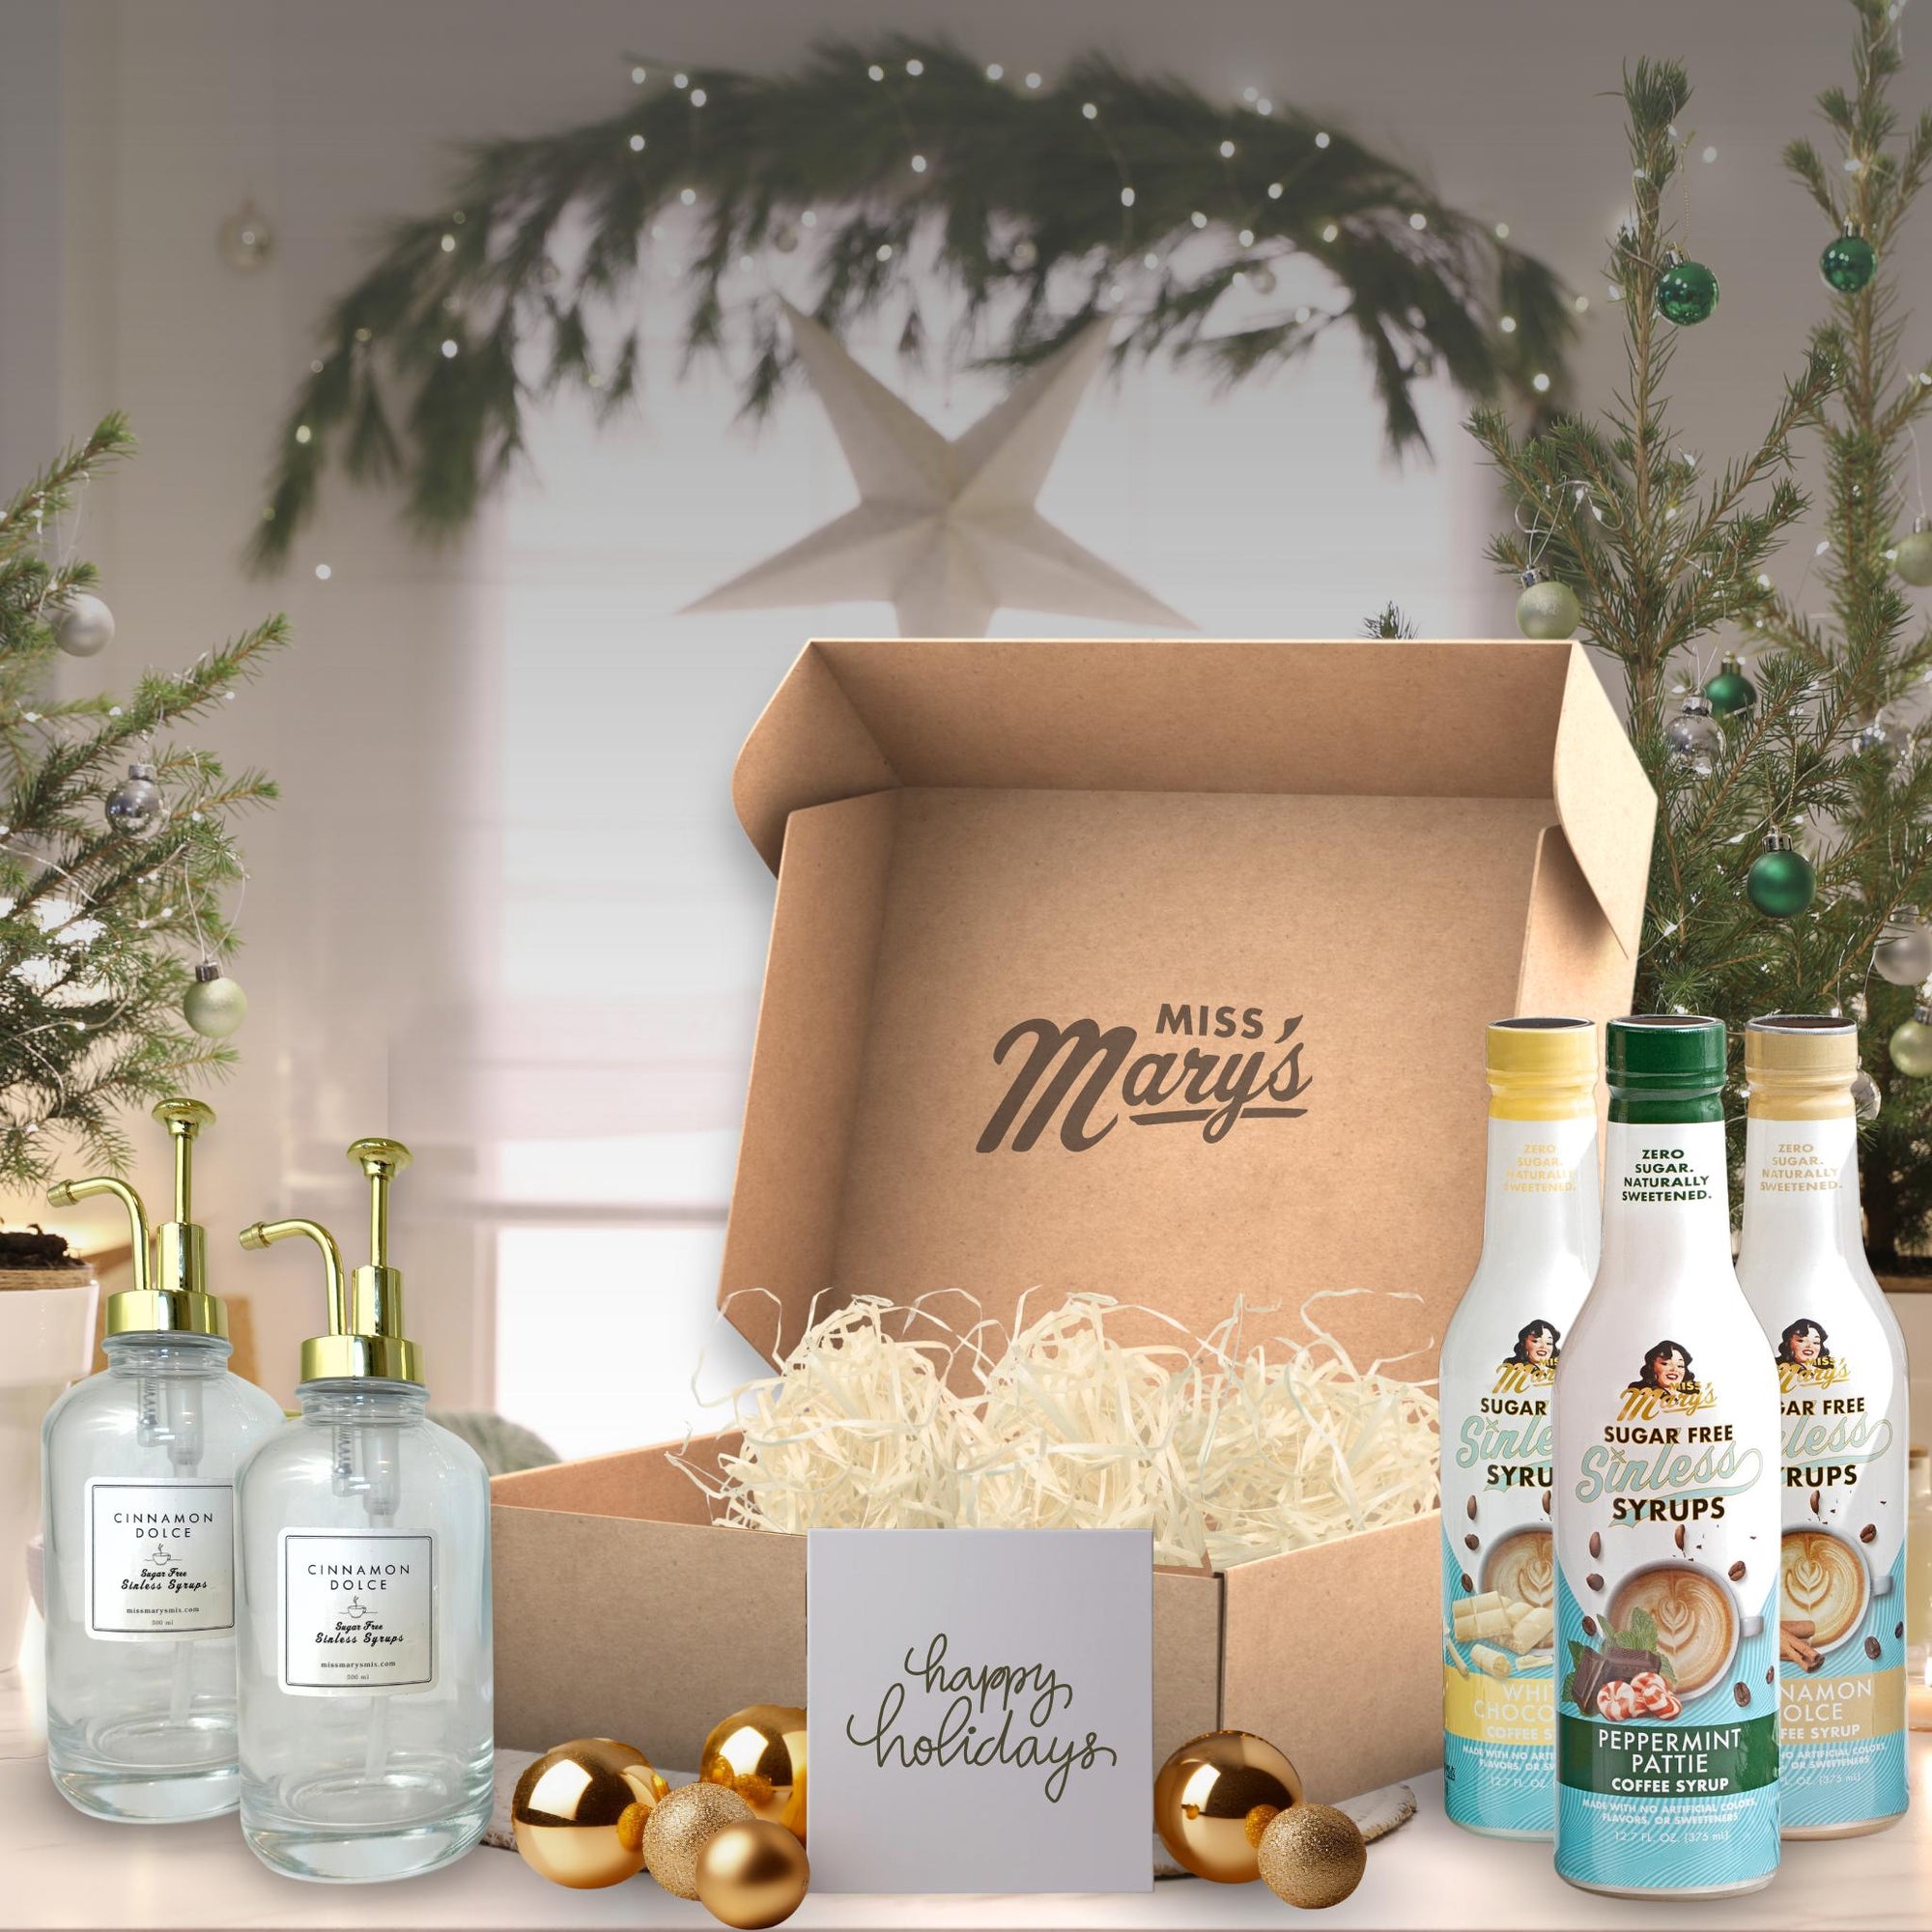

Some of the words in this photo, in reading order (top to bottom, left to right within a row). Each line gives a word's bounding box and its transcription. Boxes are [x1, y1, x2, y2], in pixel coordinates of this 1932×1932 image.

[1155, 1003, 1264, 1039] MISS
[976, 1014, 1313, 1152] Mary's
[1523, 1144, 1556, 1154] ZERO
[1641, 1149, 1685, 1160] ZERO
[1777, 1143, 1815, 1153] ZERO
[1634, 1162, 1694, 1174] SUGAR.
[1771, 1155, 1825, 1167] SUGAR.
[1761, 1167, 1839, 1179] NATURALLY
[1624, 1175, 1710, 1188] NATURALLY
[1759, 1180, 1844, 1192] SWEETENED.
[1622, 1189, 1713, 1202] SWEETENED.
[1806, 1356, 1835, 1366] MISS
[1492, 1362, 1556, 1394] Mar
[1668, 1380, 1701, 1391] MISS
[1480, 1397, 1548, 1416] SUGAR
[1616, 1381, 1719, 1422] Mary's
[1823, 1397, 1865, 1415] FREE
[1456, 1415, 1553, 1468] Sinle
[1604, 1425, 1680, 1444] SUGAR
[1688, 1424, 1734, 1443] FREE
[1486, 1463, 1553, 1488] SYRU
[1576, 1441, 1763, 1503] Sinless
[1781, 1463, 1858, 1488] RUPS
[1612, 1496, 1725, 1521] SYRUPS
[114, 1512, 213, 1523] CINNAMON
[135, 1527, 191, 1539] DOLCE
[140, 1568, 166, 1581] Sugar
[167, 1567, 187, 1577] Free
[307, 1564, 410, 1576] CINNAMON
[121, 1578, 162, 1591] Sinless
[167, 1578, 208, 1594] Syrups
[330, 1579, 387, 1590] DOLCE
[127, 1606, 200, 1616] missmarysmix.com
[335, 1621, 361, 1634] Sugar
[362, 1620, 384, 1631] Free
[315, 1632, 357, 1644] Sinless
[363, 1632, 404, 1647] Syrups
[321, 1661, 396, 1670] missmarysmix.com
[904, 1633, 1073, 1727] happy
[1502, 1684, 1554, 1703] WHI
[1780, 1678, 1872, 1702] NAMON
[1473, 1699, 1555, 1723] CHOCO
[1783, 1703, 1843, 1722] OLCE
[1486, 1724, 1539, 1742] COFFEE
[1780, 1727, 1805, 1740] FEE
[1810, 1723, 1861, 1740] SYRUP
[846, 1683, 1118, 1804] holidays
[1599, 1727, 1742, 1752] PEPPERMINT
[1462, 1745, 1484, 1756] MADE
[1486, 1749, 1509, 1759] WITH
[1511, 1751, 1528, 1761] NO
[1798, 1747, 1852, 1759] ARTIFICIAL
[1525, 1763, 1540, 1772] OR
[1632, 1753, 1708, 1774] PATTIE
[1791, 1761, 1806, 1771] OR
[1611, 1777, 1670, 1793] COFFEE
[1676, 1777, 1729, 1793] SYRUP
[1582, 1799, 1607, 1810] MADE
[1608, 1803, 1636, 1813] WITH
[1639, 1804, 1658, 1814] NO
[1662, 1803, 1718, 1814] ARTIFICIAL
[1602, 1812, 1651, 1826] FLAVORS,
[1654, 1815, 1670, 1826] OR
[1674, 1812, 1740, 1826] SWEETENERS
[1614, 1831, 1637, 1842] 12.7
